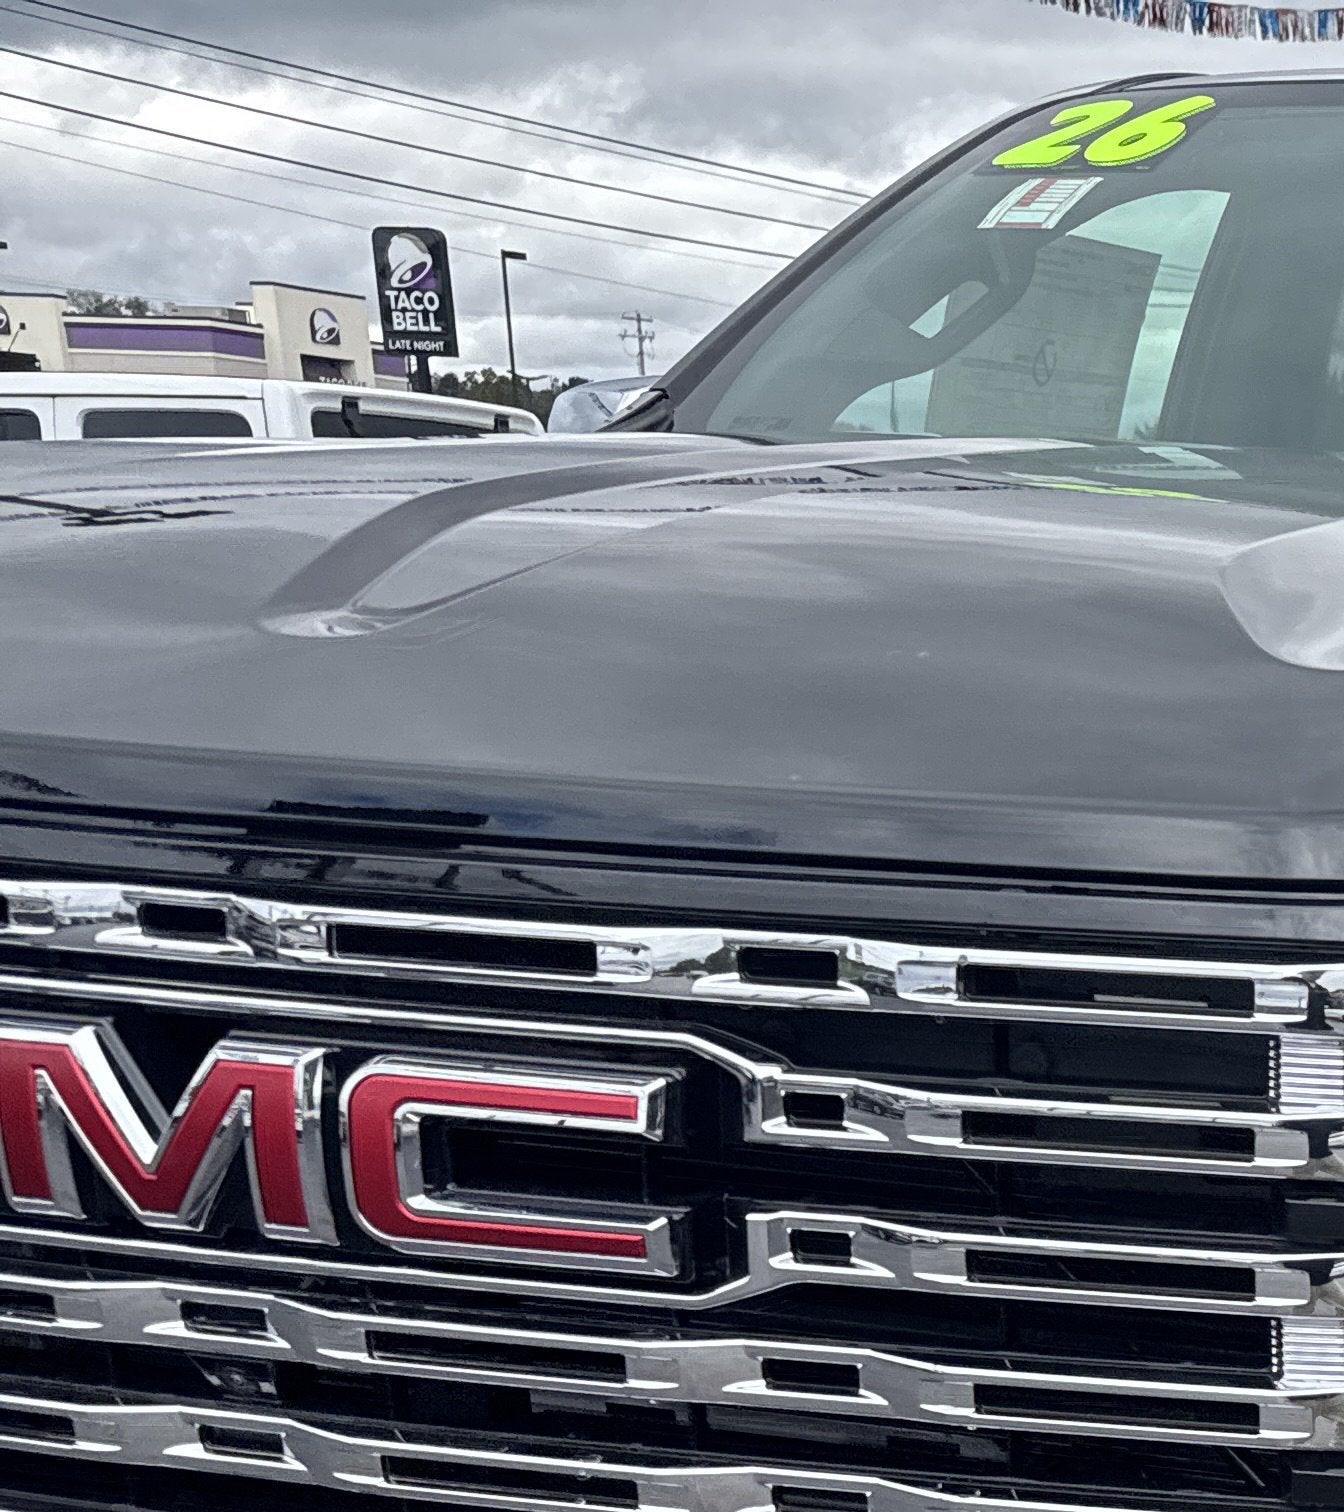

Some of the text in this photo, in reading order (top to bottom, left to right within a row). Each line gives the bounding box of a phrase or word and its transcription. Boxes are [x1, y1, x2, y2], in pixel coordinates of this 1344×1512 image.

[991, 95, 1216, 168] 26
[384, 290, 440, 311] TACO
[391, 311, 442, 332] BELL
[388, 339, 445, 352] LATE NIGHT
